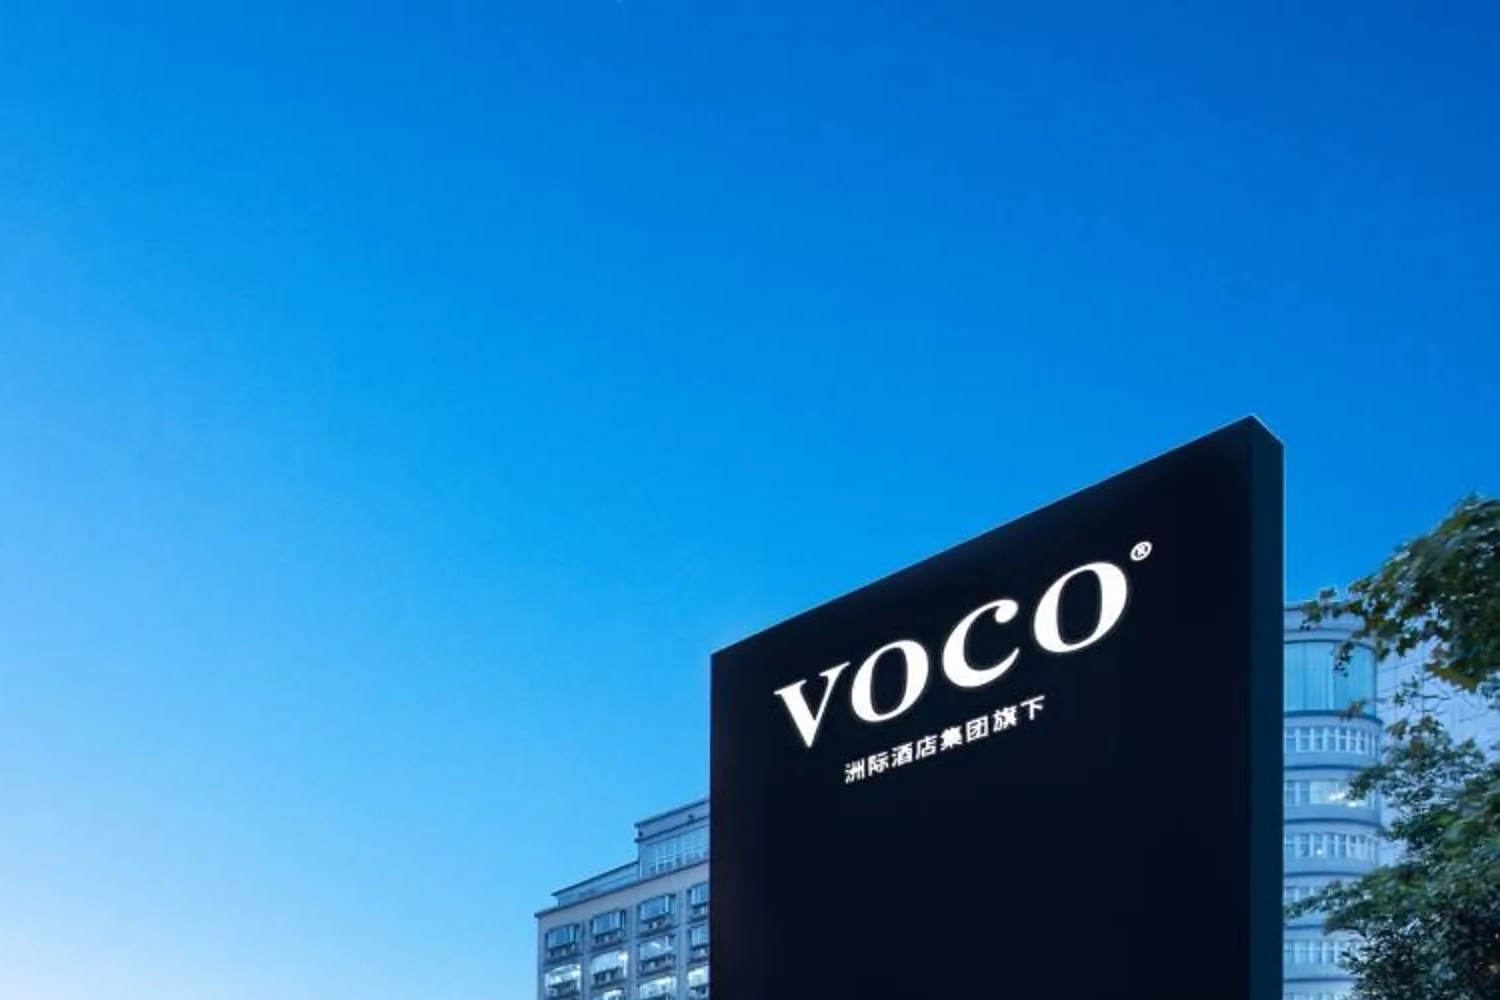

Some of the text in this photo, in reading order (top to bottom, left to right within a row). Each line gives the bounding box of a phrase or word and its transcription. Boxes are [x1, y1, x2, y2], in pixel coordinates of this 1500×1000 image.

[844, 695, 1046, 784] 洲际酒店集团旗下
